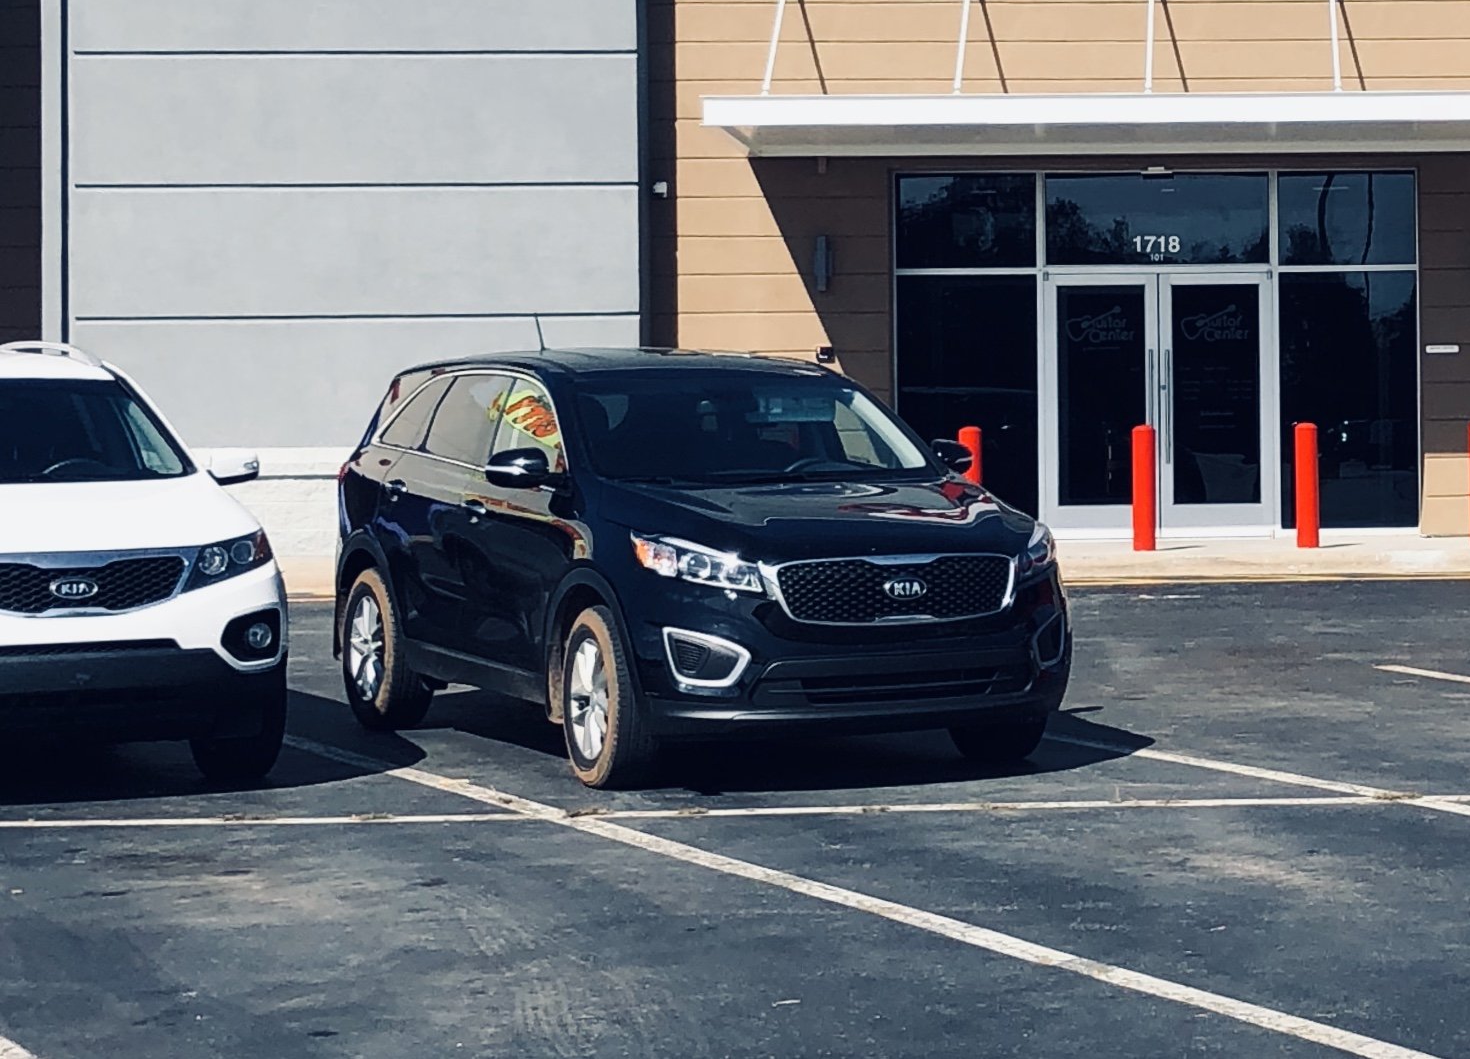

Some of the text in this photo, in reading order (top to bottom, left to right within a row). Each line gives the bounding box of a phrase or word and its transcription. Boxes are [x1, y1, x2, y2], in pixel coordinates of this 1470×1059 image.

[1132, 235, 1181, 253] 1718
[1150, 253, 1164, 262] 101
[1089, 329, 1136, 343] Center
[1204, 328, 1250, 342] Center
